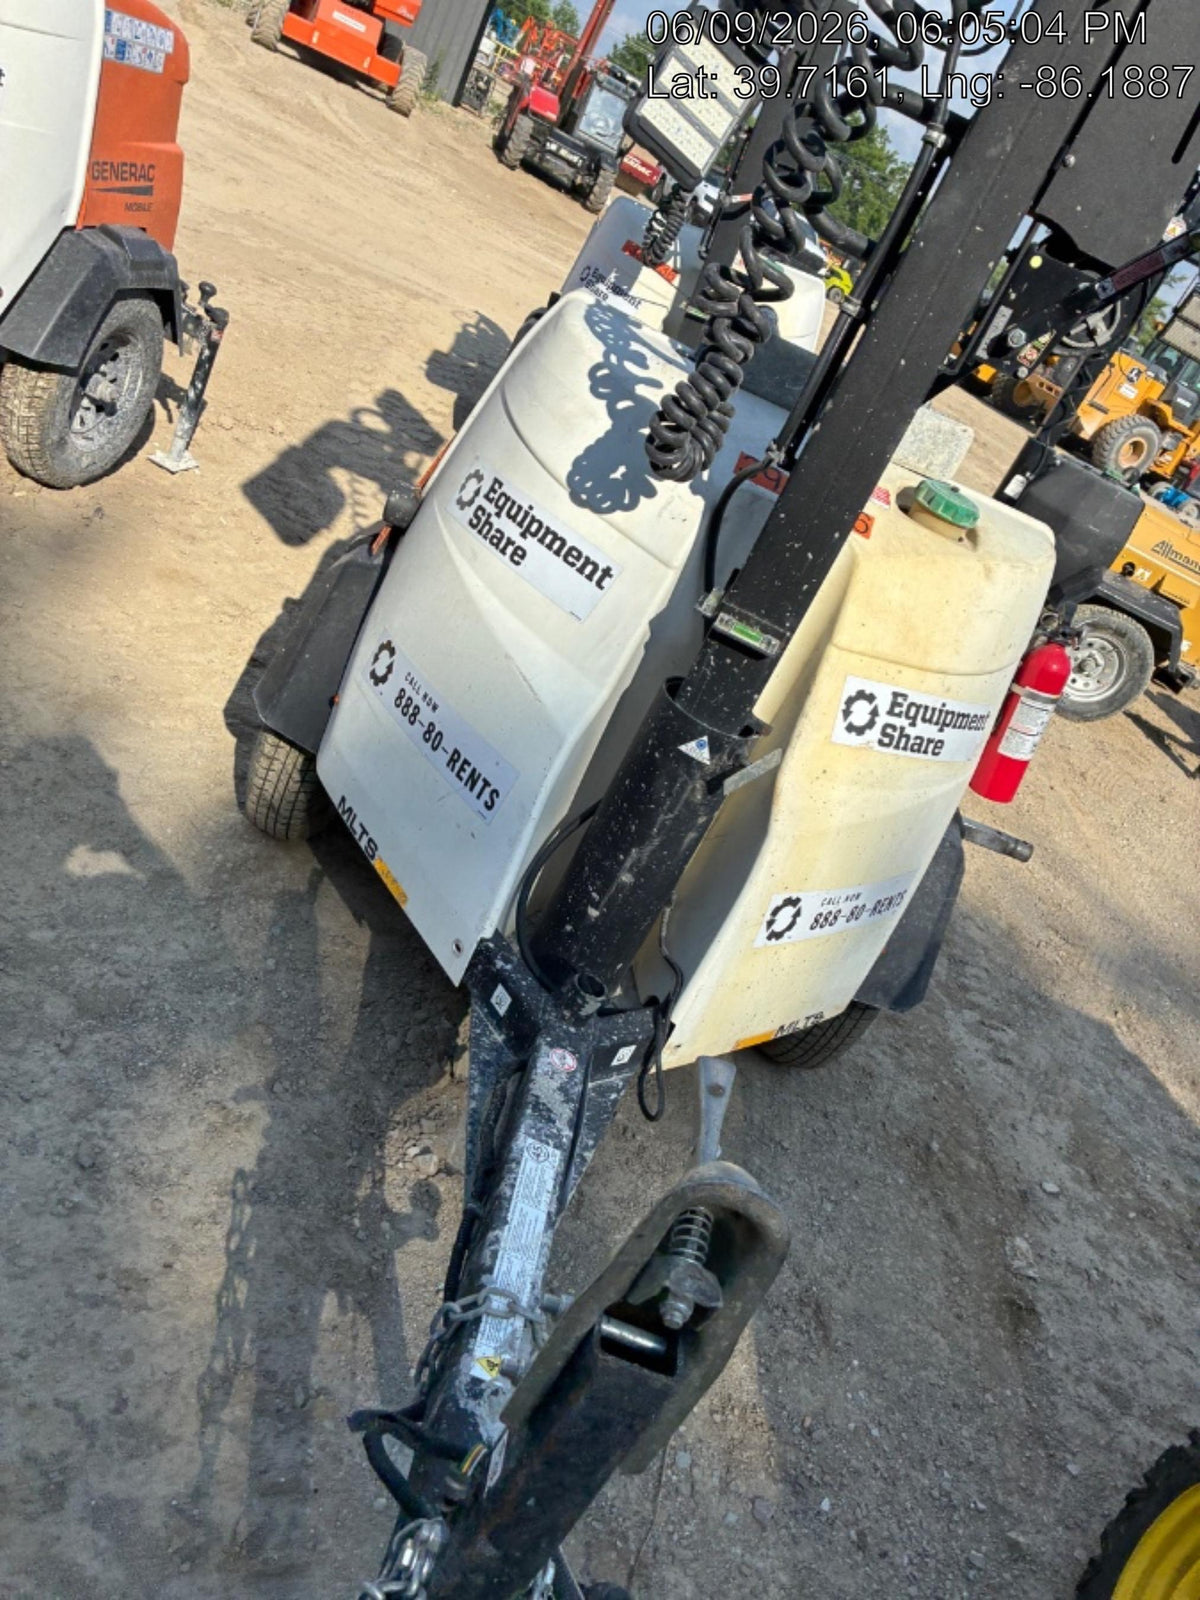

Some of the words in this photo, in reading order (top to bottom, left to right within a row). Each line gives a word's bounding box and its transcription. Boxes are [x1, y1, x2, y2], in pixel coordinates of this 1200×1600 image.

[91, 161, 156, 182] GENERAC
[468, 504, 528, 567] Share
[483, 476, 614, 591] Equipment
[404, 671, 422, 695] CALL
[422, 692, 440, 713] NOW
[886, 691, 990, 733] Equipment
[393, 687, 500, 812] 888-80-RENTS
[878, 722, 945, 756] Share
[337, 794, 379, 861] MLTS
[820, 896, 841, 908] CALL
